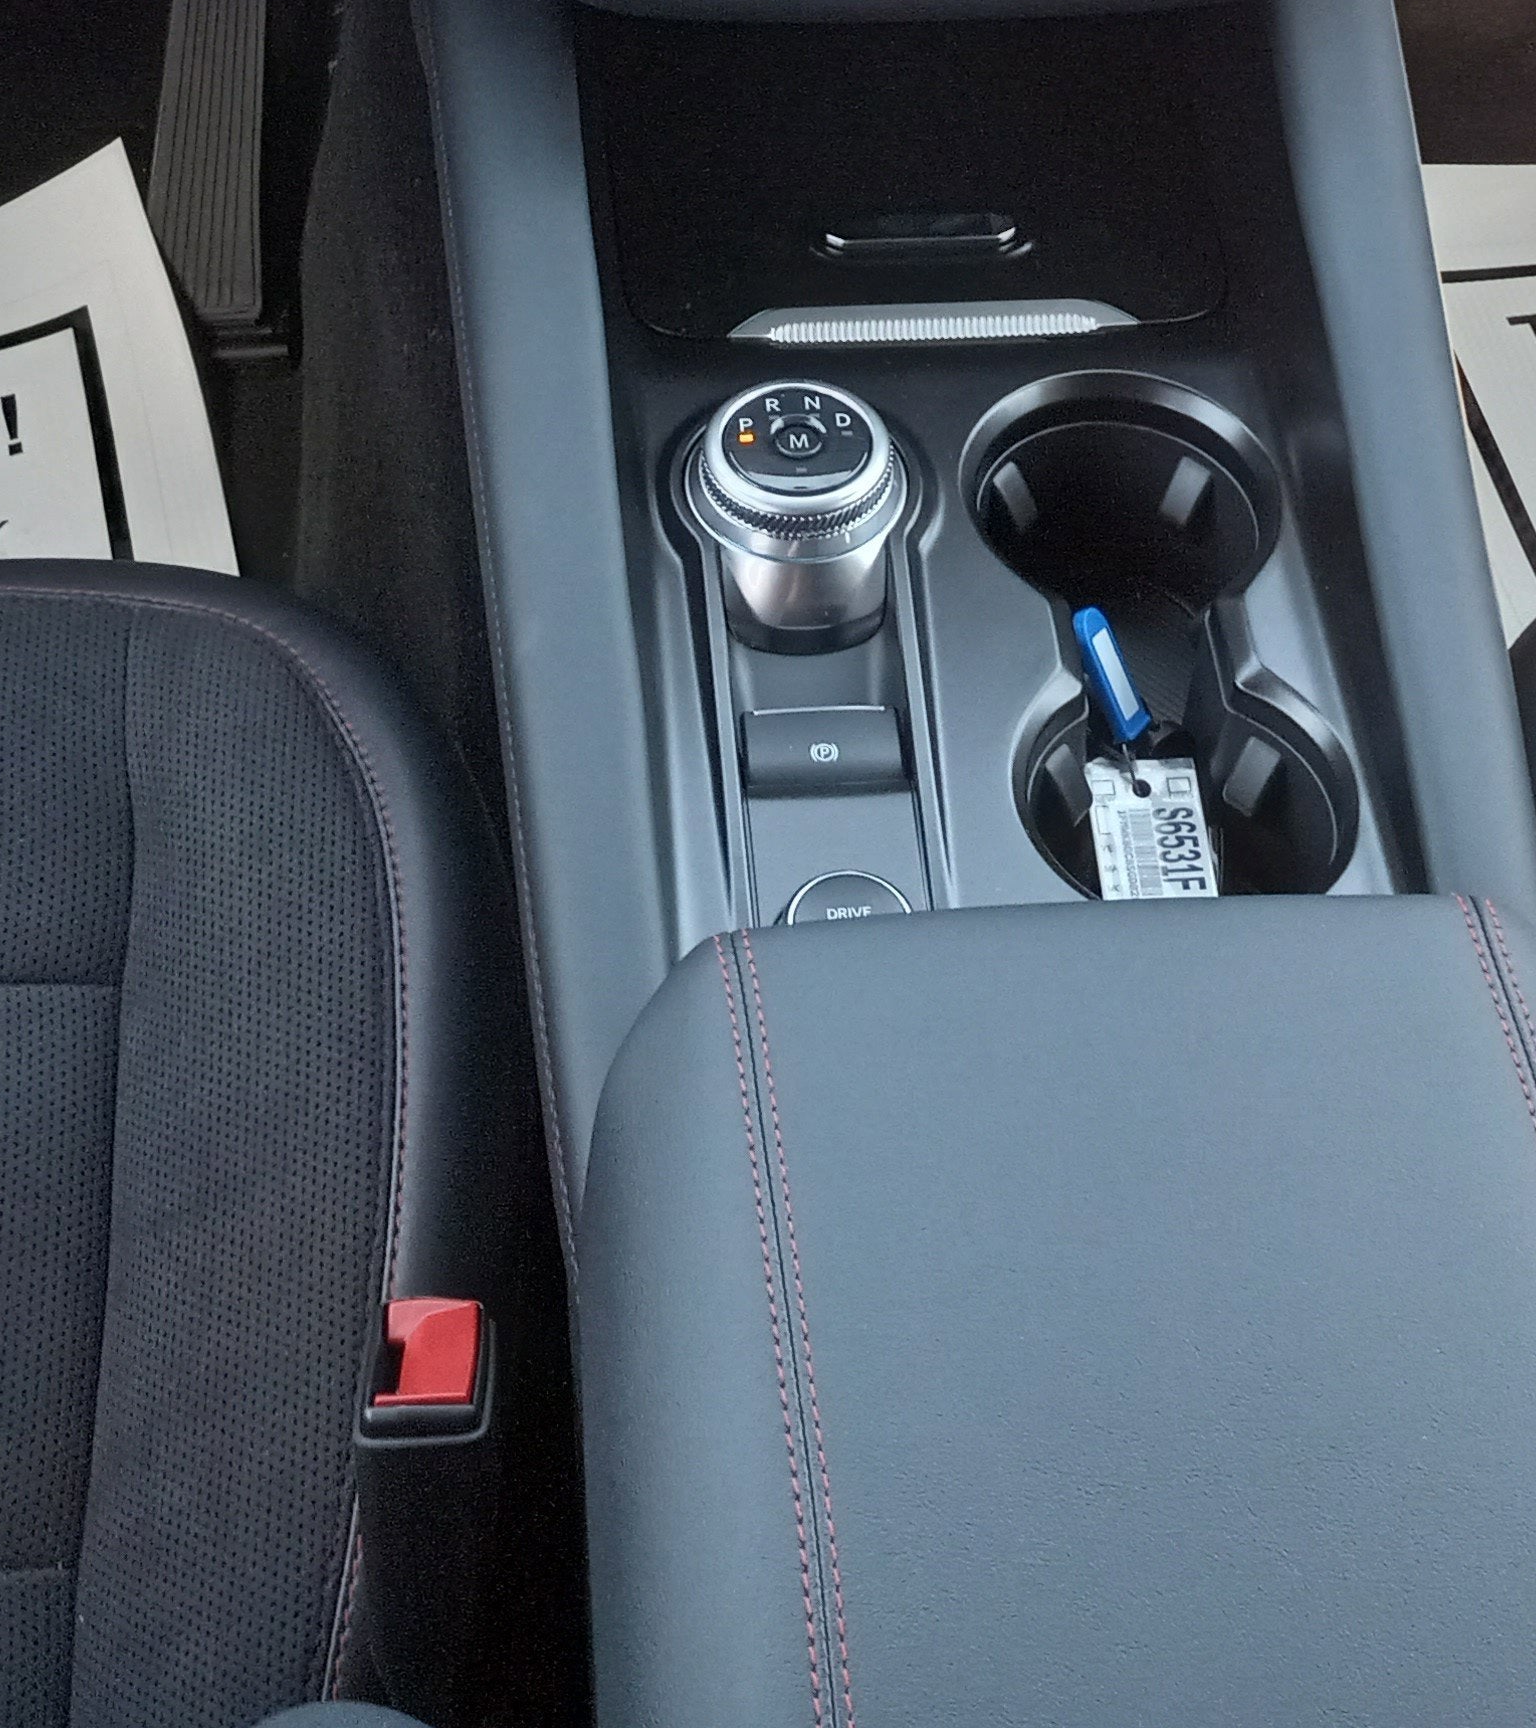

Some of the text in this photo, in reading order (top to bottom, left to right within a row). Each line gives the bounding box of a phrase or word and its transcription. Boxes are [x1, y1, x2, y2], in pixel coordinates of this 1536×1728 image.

[738, 395, 852, 432] P R N D
[789, 433, 810, 449] M
[1152, 807, 1207, 891] S6531F
